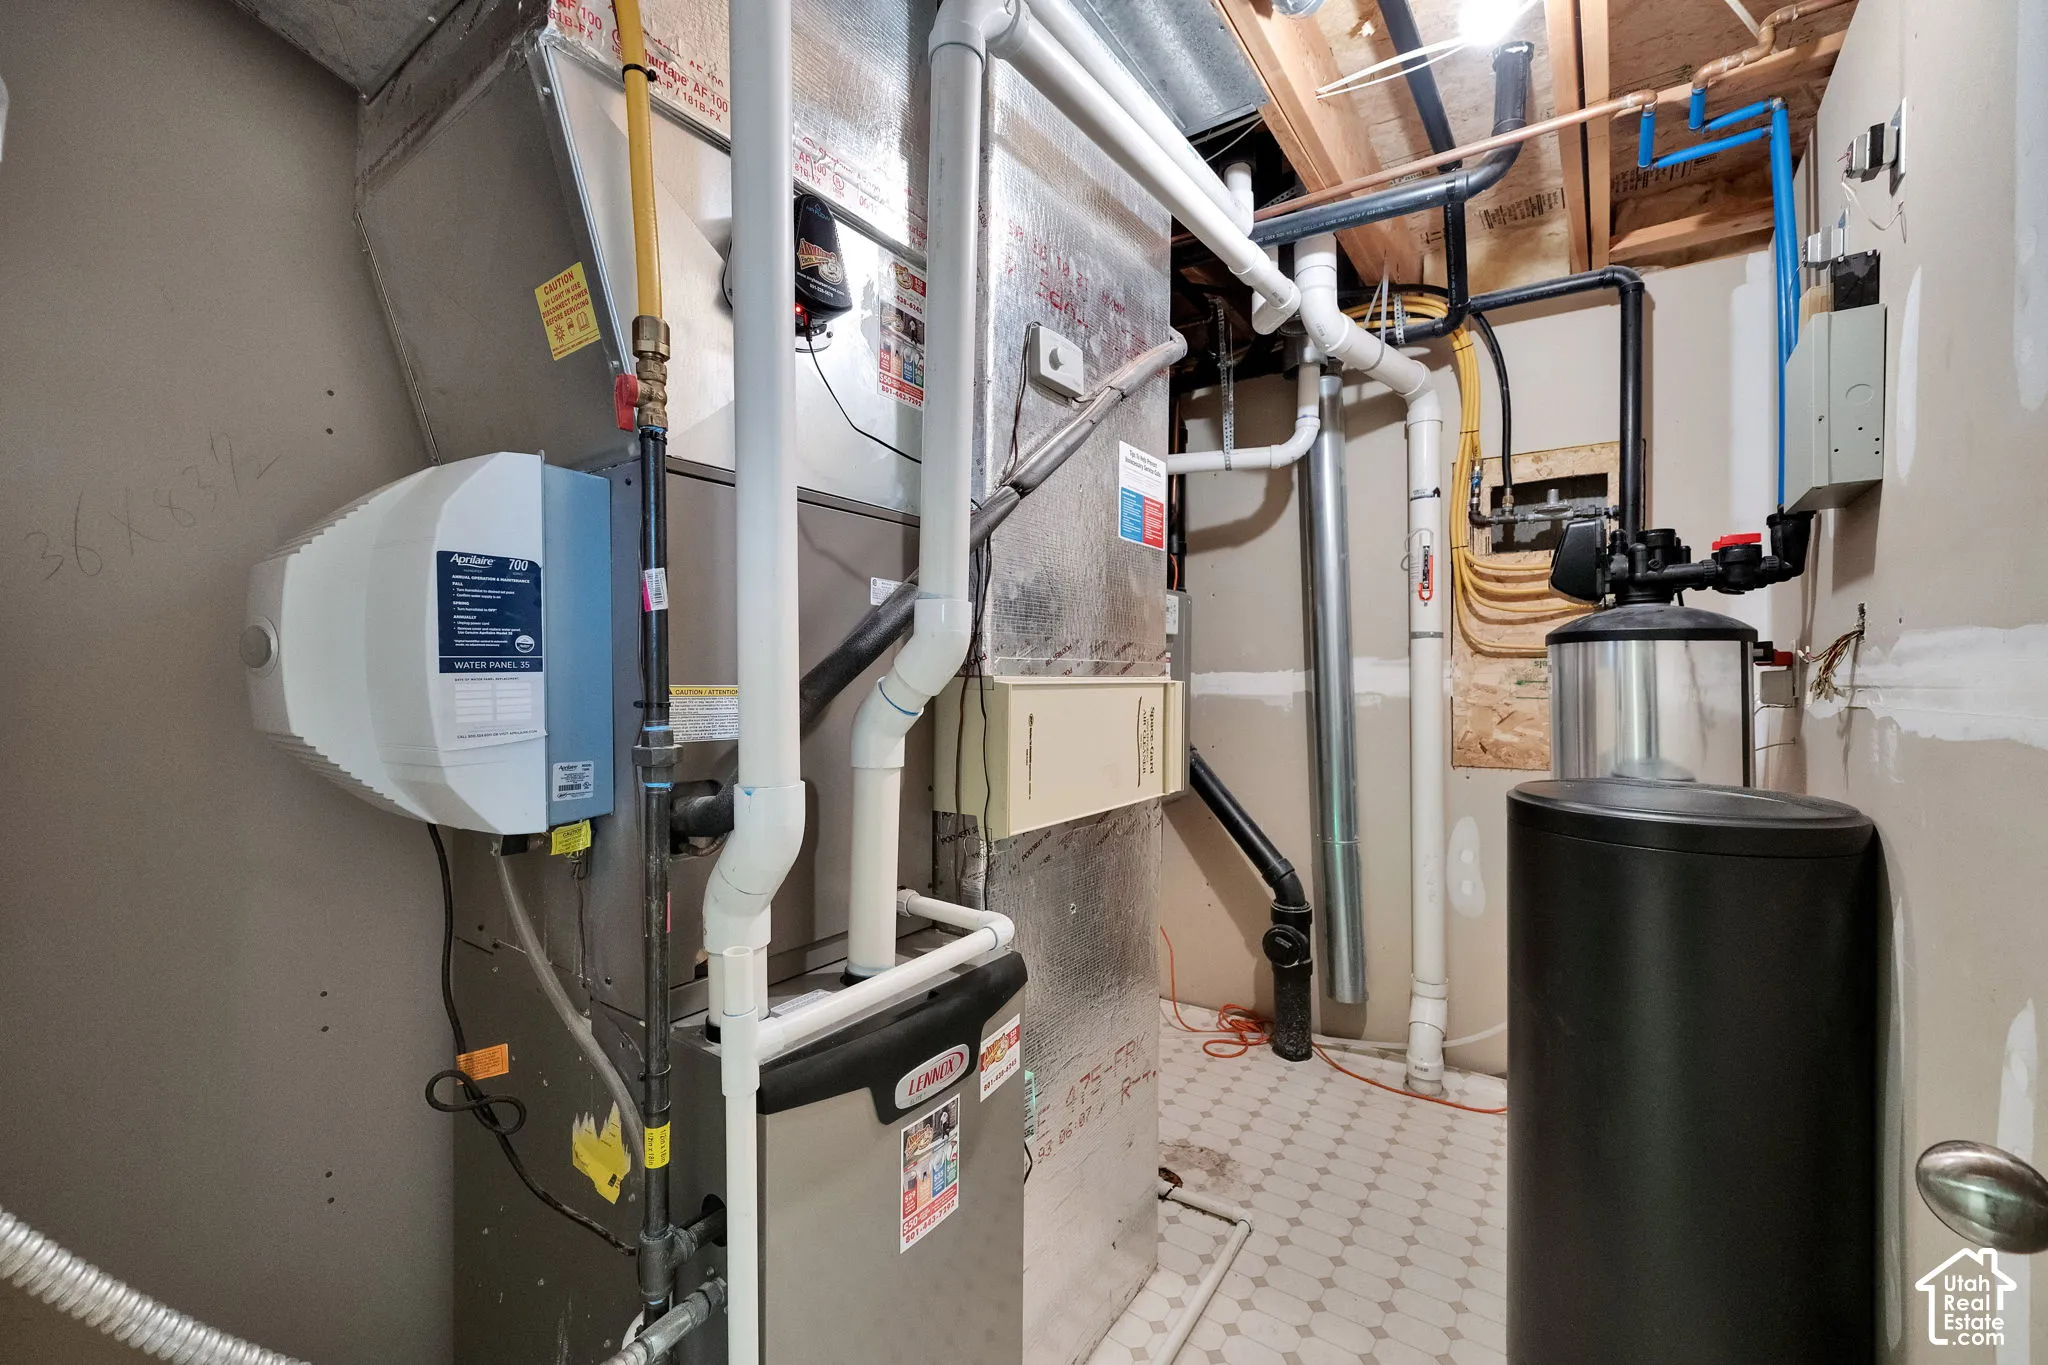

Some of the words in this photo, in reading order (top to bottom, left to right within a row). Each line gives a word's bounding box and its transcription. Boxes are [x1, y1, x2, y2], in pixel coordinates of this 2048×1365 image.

[682, 91, 722, 123] 181B-FX
[693, 82, 709, 98] AF
[710, 93, 728, 113] 100
[543, 270, 575, 296] CAUTION
[550, 290, 565, 304] LIGHT
[571, 281, 582, 292] USE
[542, 299, 571, 319] DISCONNECT
[571, 288, 589, 303] POWER
[546, 312, 564, 327] BEFORE
[563, 298, 590, 317] SERVICING
[450, 553, 495, 566] Aprilaire
[508, 558, 529, 571] 700
[454, 661, 487, 669] WATER
[489, 661, 518, 669] PANEL
[520, 661, 530, 669] 35
[908, 1056, 955, 1097] LENNOX
[903, 1215, 918, 1234] $50
